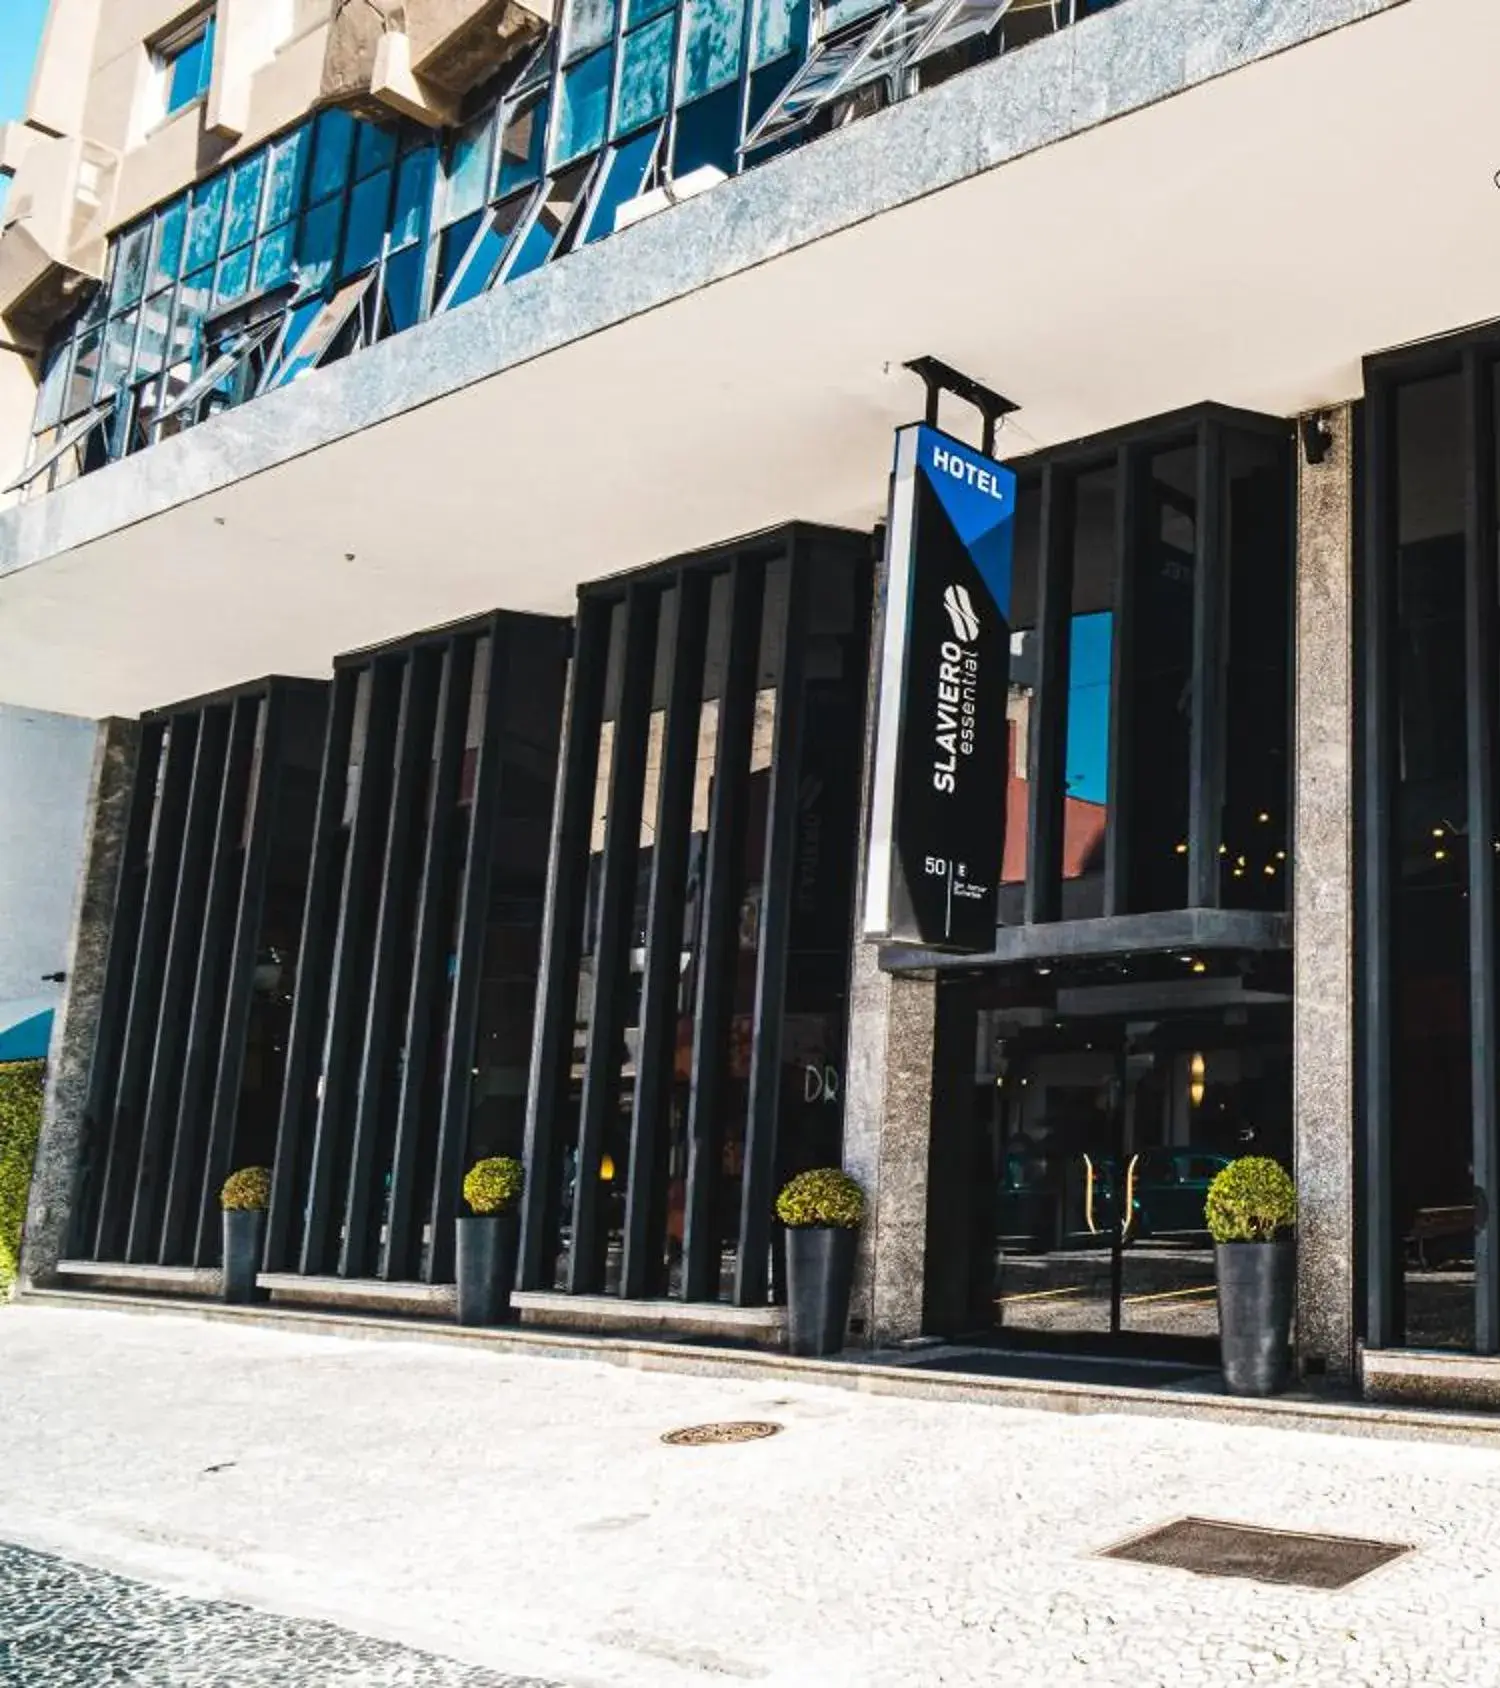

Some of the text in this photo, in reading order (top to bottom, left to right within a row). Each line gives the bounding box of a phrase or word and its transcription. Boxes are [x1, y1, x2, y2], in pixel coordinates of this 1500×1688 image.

[933, 446, 1003, 500] HOTEL
[933, 640, 962, 793] SLAVIERO
[960, 648, 978, 756] essential
[925, 856, 946, 875] 50
